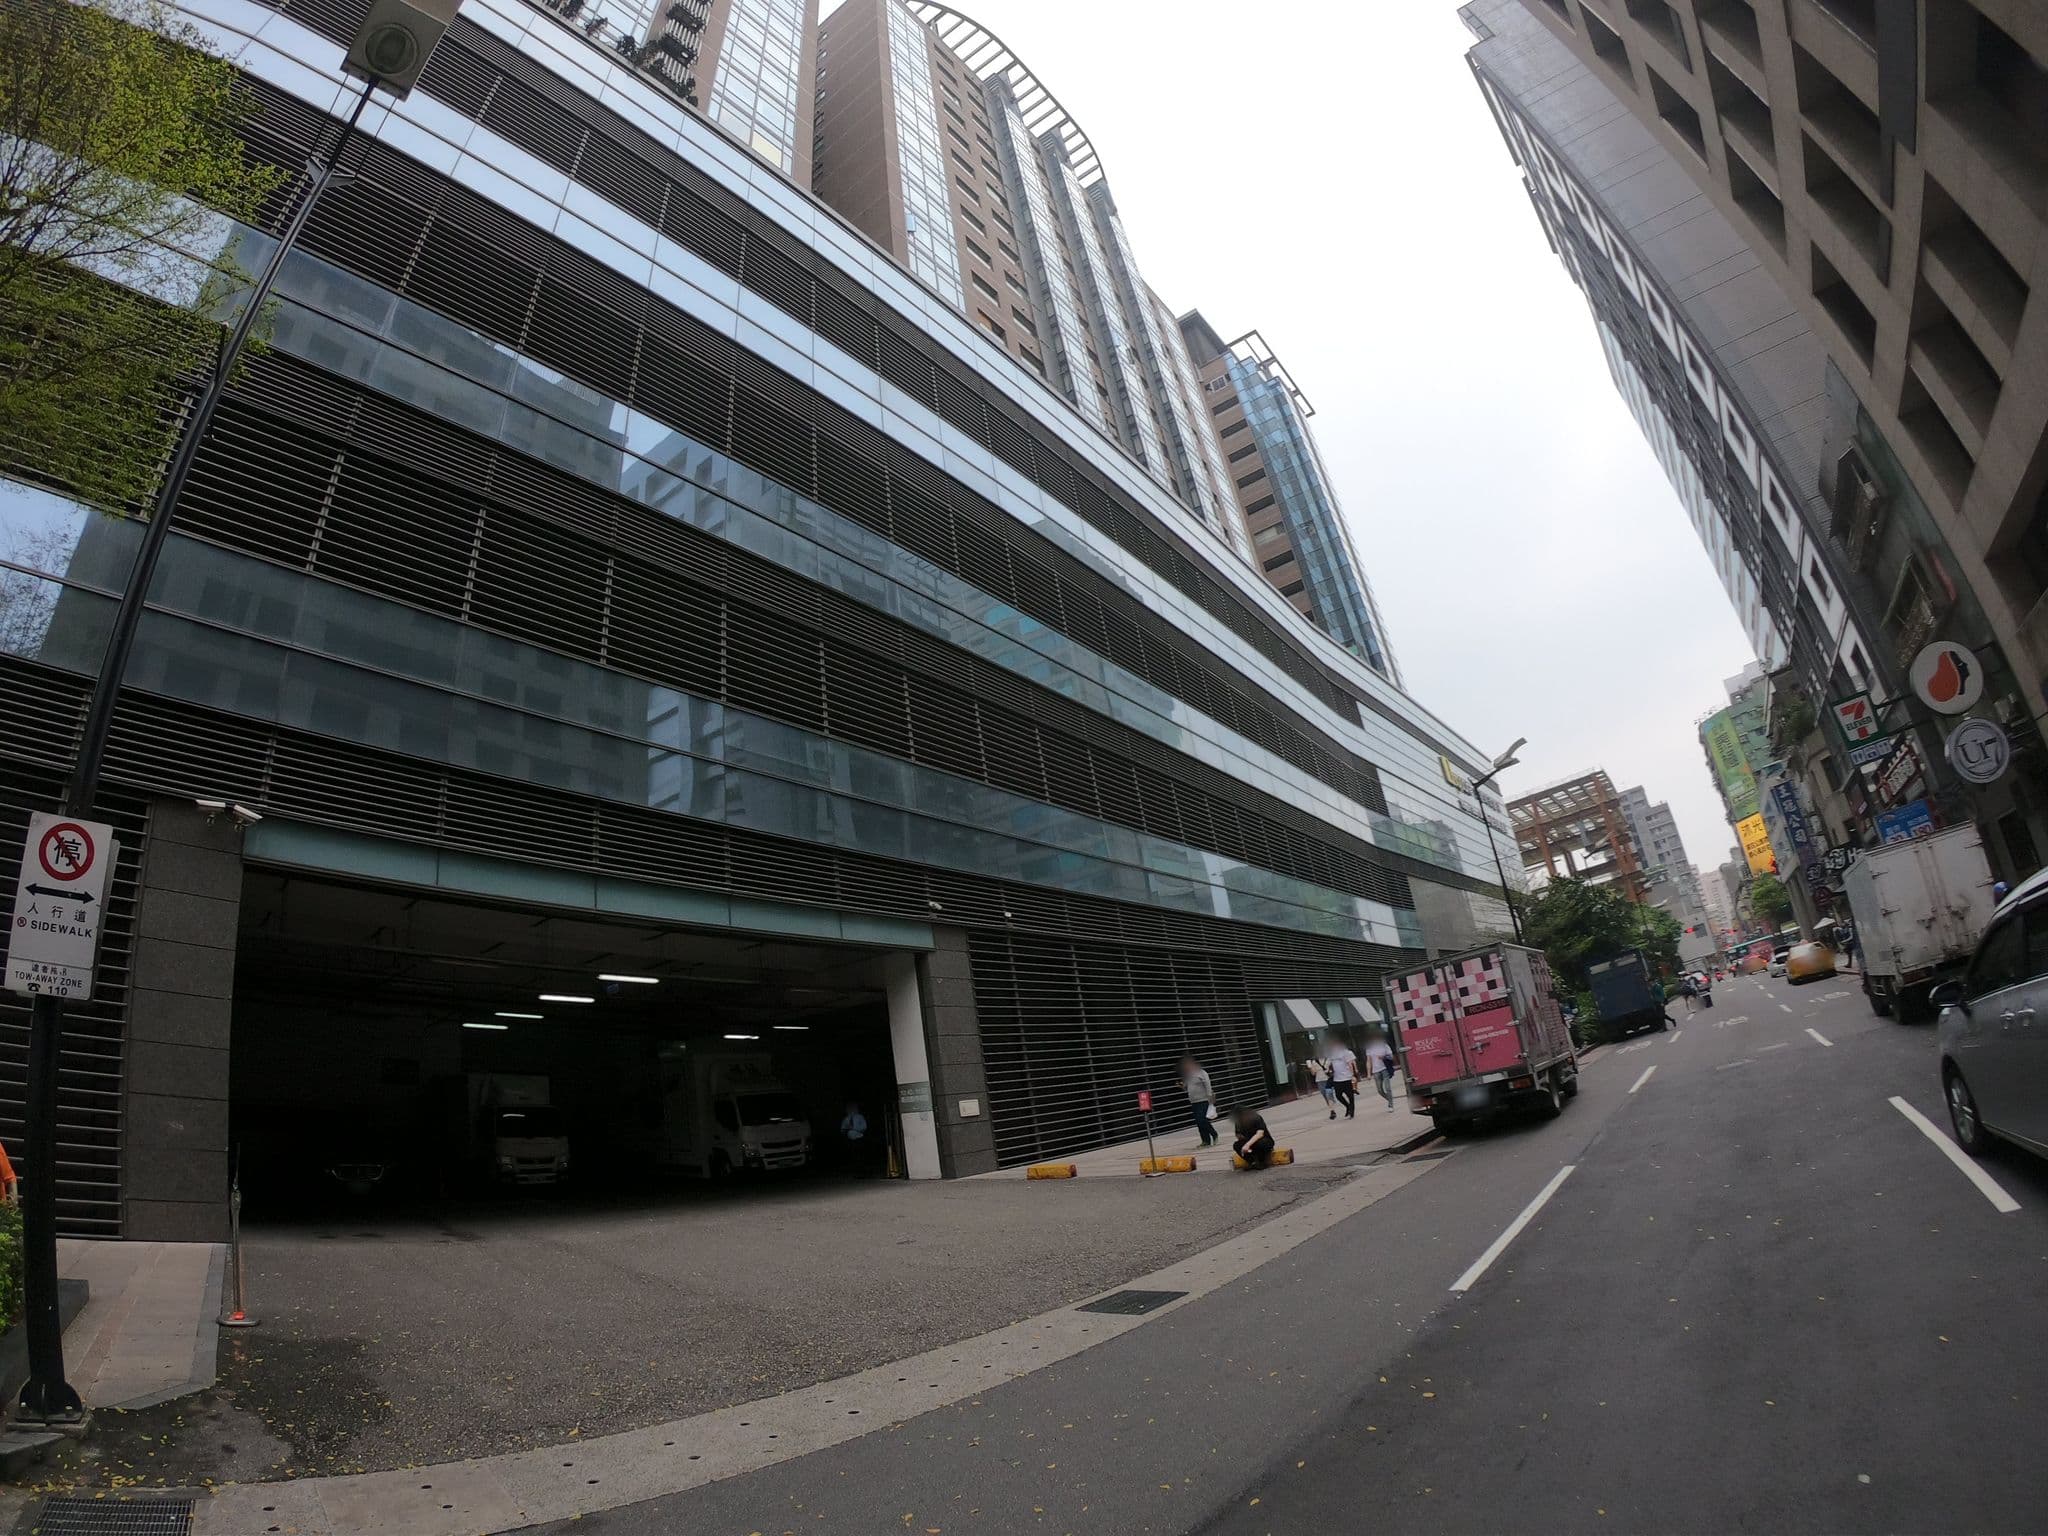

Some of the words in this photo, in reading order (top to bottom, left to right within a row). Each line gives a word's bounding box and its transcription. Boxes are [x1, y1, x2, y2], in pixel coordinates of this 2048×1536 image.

[54, 837, 82, 867] 停
[27, 902, 87, 924] 人行道
[30, 920, 93, 938] SIDEWALK
[47, 985, 68, 996] 110
[60, 977, 83, 989] ZONE
